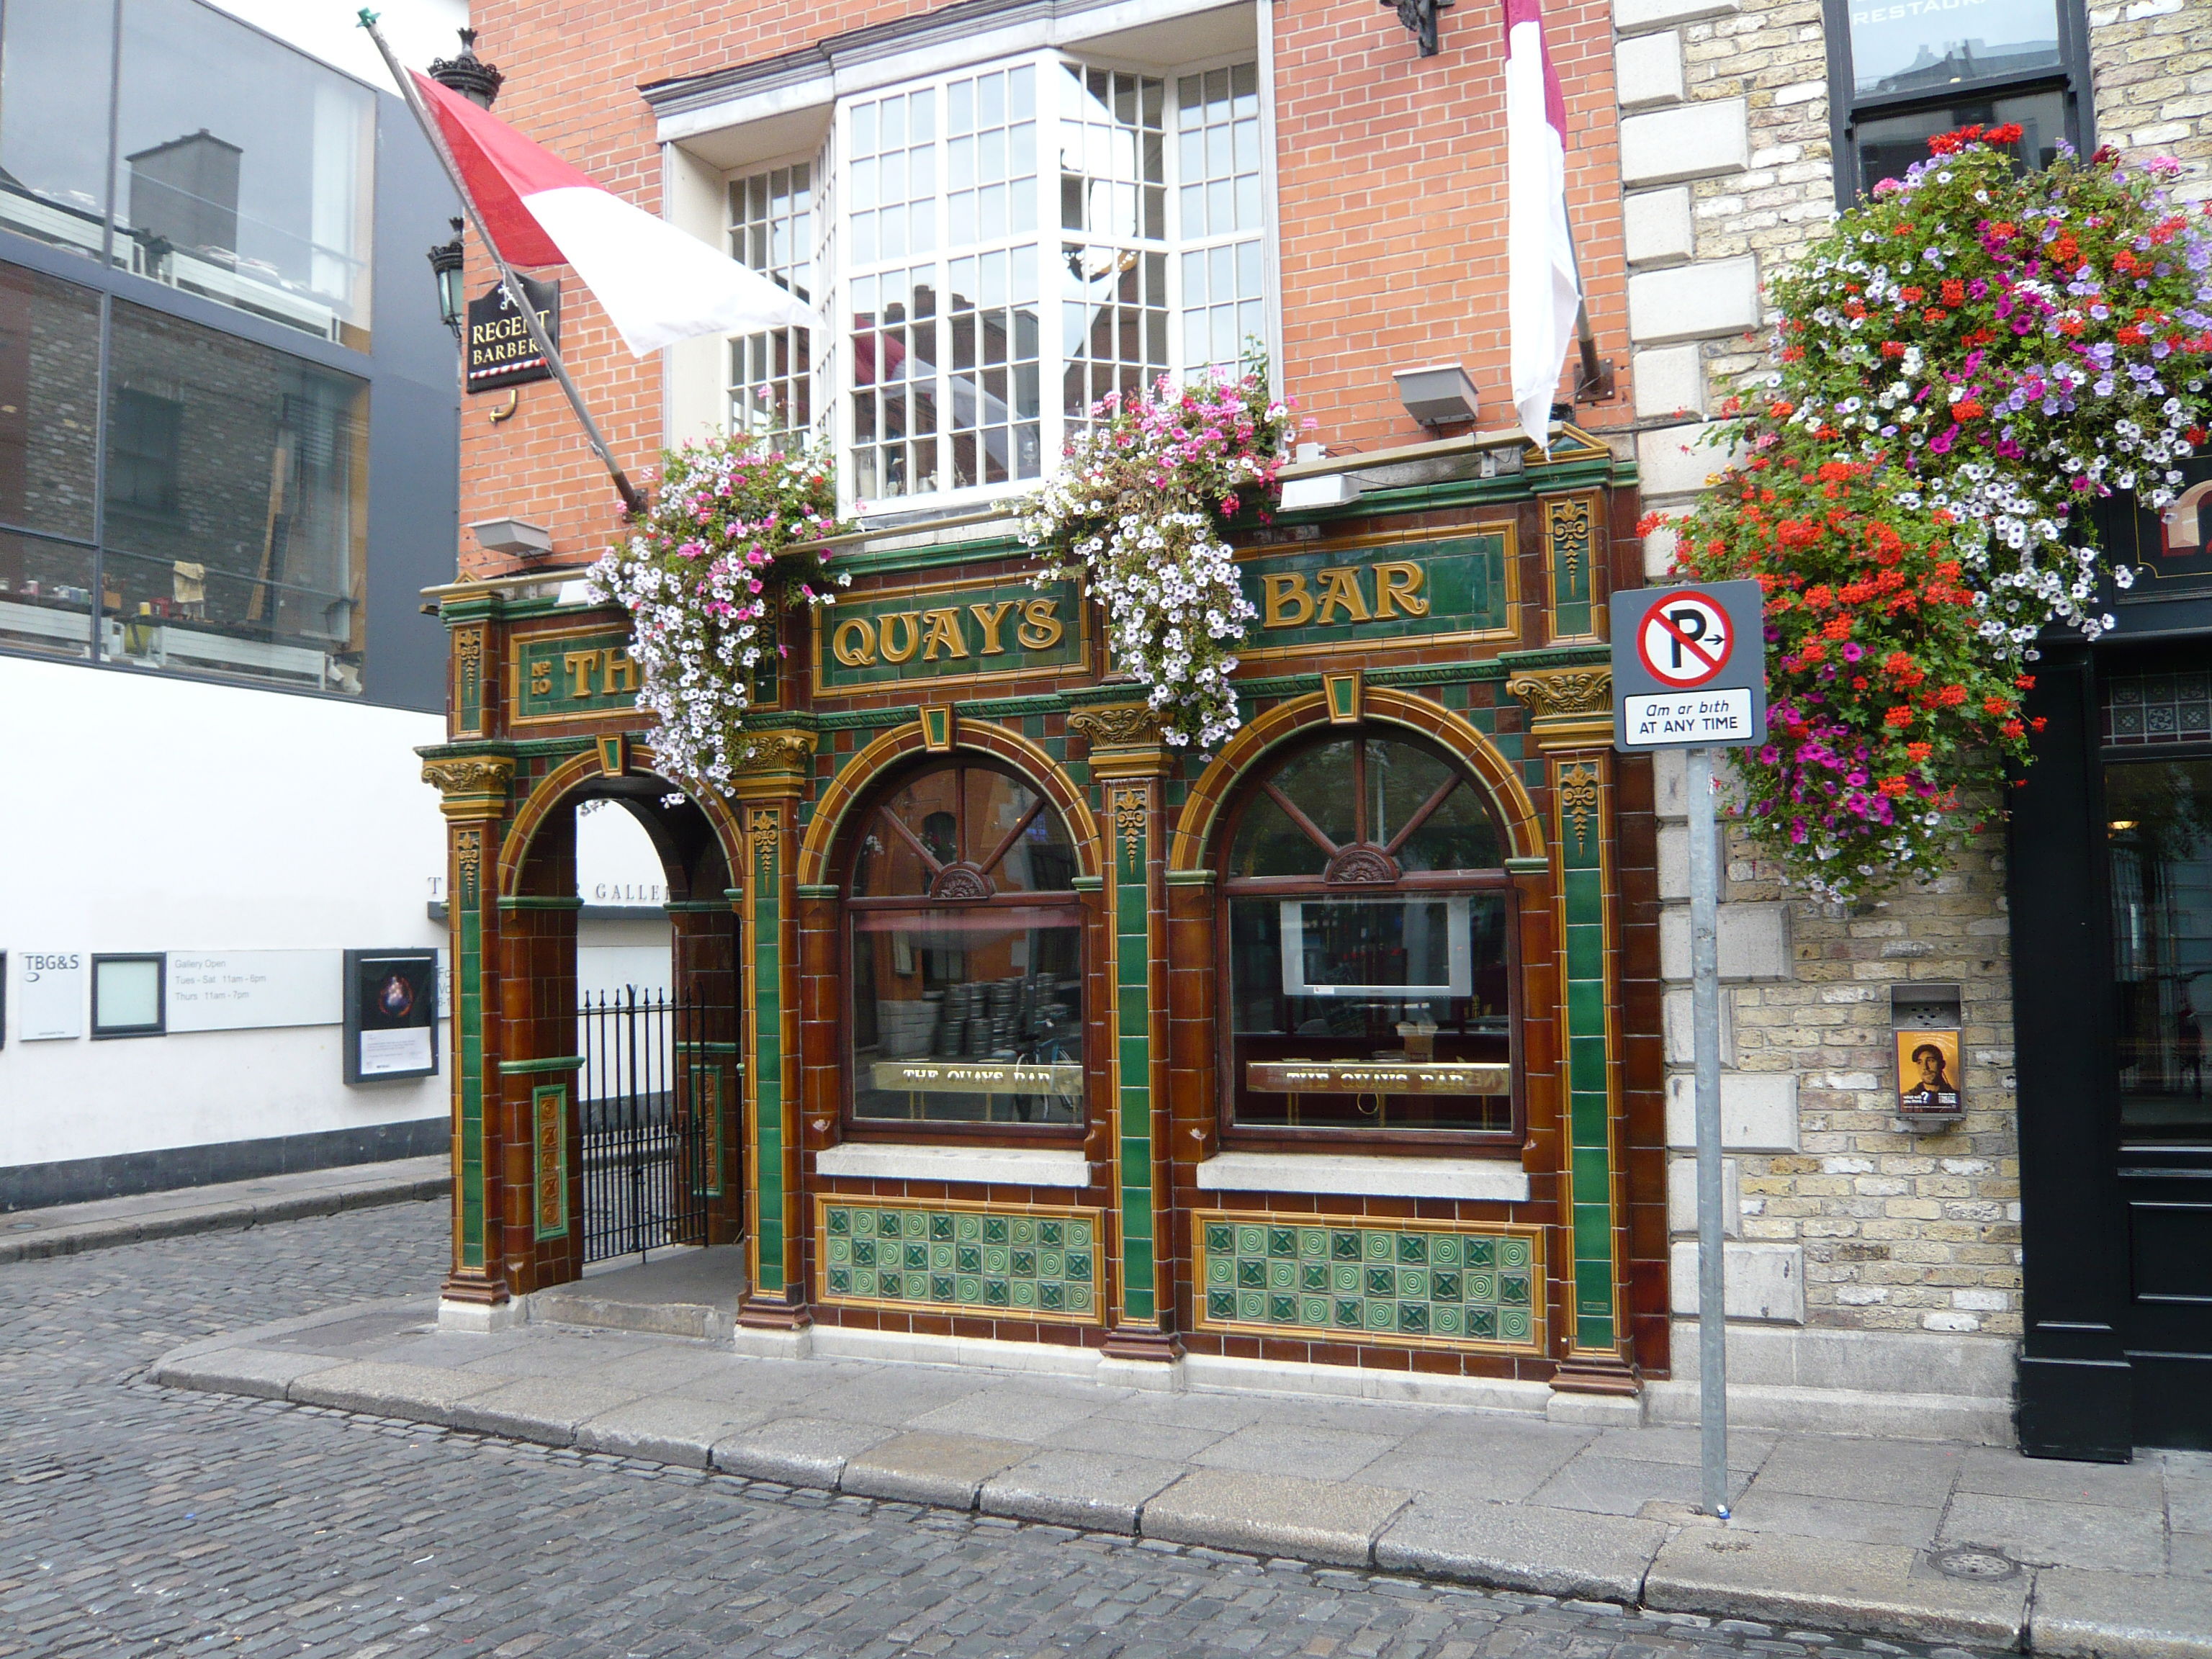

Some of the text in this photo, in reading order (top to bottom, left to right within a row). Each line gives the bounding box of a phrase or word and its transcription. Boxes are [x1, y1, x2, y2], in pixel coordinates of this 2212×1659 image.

[832, 598, 1064, 667] QUAY'S
[1262, 561, 1430, 629] BAR
[1677, 704, 1694, 715] ar
[1639, 716, 1738, 734] AT ANY TIME
[24, 954, 79, 971] TBG&S
[174, 958, 226, 970] Gallery Open
[175, 976, 196, 984] Tues
[202, 975, 216, 984] Sat
[222, 975, 243, 984] 11am
[175, 992, 198, 1001] Thurs
[205, 992, 226, 1000] 11am
[903, 1069, 939, 1082] THE
[947, 1069, 1004, 1084] QUAYS
[1286, 1072, 1329, 1089] THE
[1341, 1072, 1408, 1090] QUAYS
